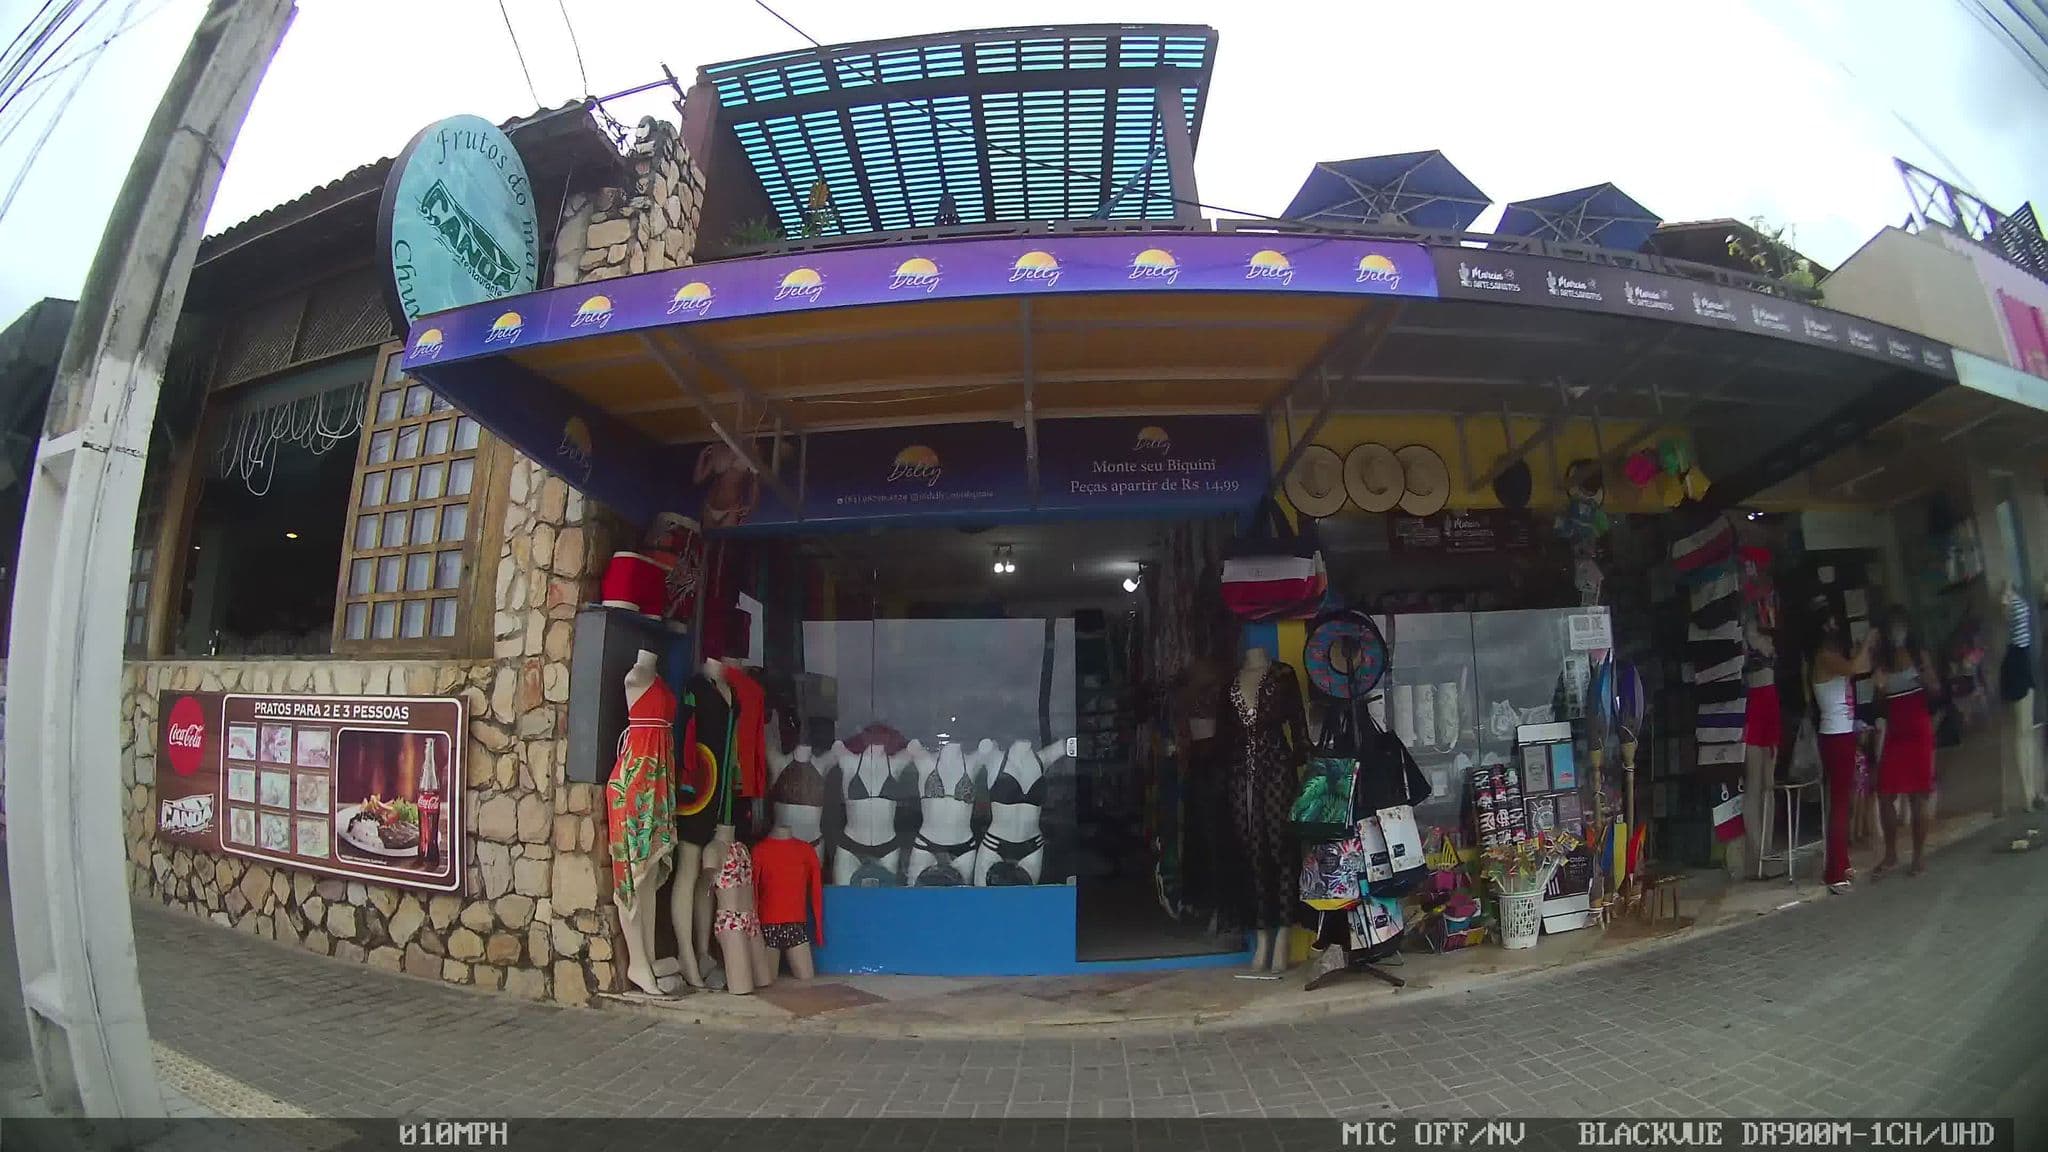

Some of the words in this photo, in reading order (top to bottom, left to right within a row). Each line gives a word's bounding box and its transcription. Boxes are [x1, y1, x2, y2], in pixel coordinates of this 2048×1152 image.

[420, 185, 514, 292] CANOA
[889, 272, 942, 292] Delly
[1009, 267, 1063, 287] Delly
[1129, 265, 1181, 285] Delly
[1245, 265, 1295, 286] Delly
[774, 284, 825, 303] Delly
[667, 297, 714, 316] Delly
[1092, 460, 1137, 473] Monte
[1141, 462, 1163, 473] seu
[1167, 459, 1216, 475] Biquini
[1070, 480, 1108, 496] Peças
[1111, 480, 1158, 495] apartir
[1161, 478, 1177, 491] de
[254, 702, 292, 715] PRATOS
[293, 703, 321, 717] PARA
[323, 705, 330, 717] 2
[333, 705, 341, 717] E
[343, 705, 350, 717] 3
[353, 705, 409, 720] PESSOAS
[161, 799, 214, 831] CANOA
